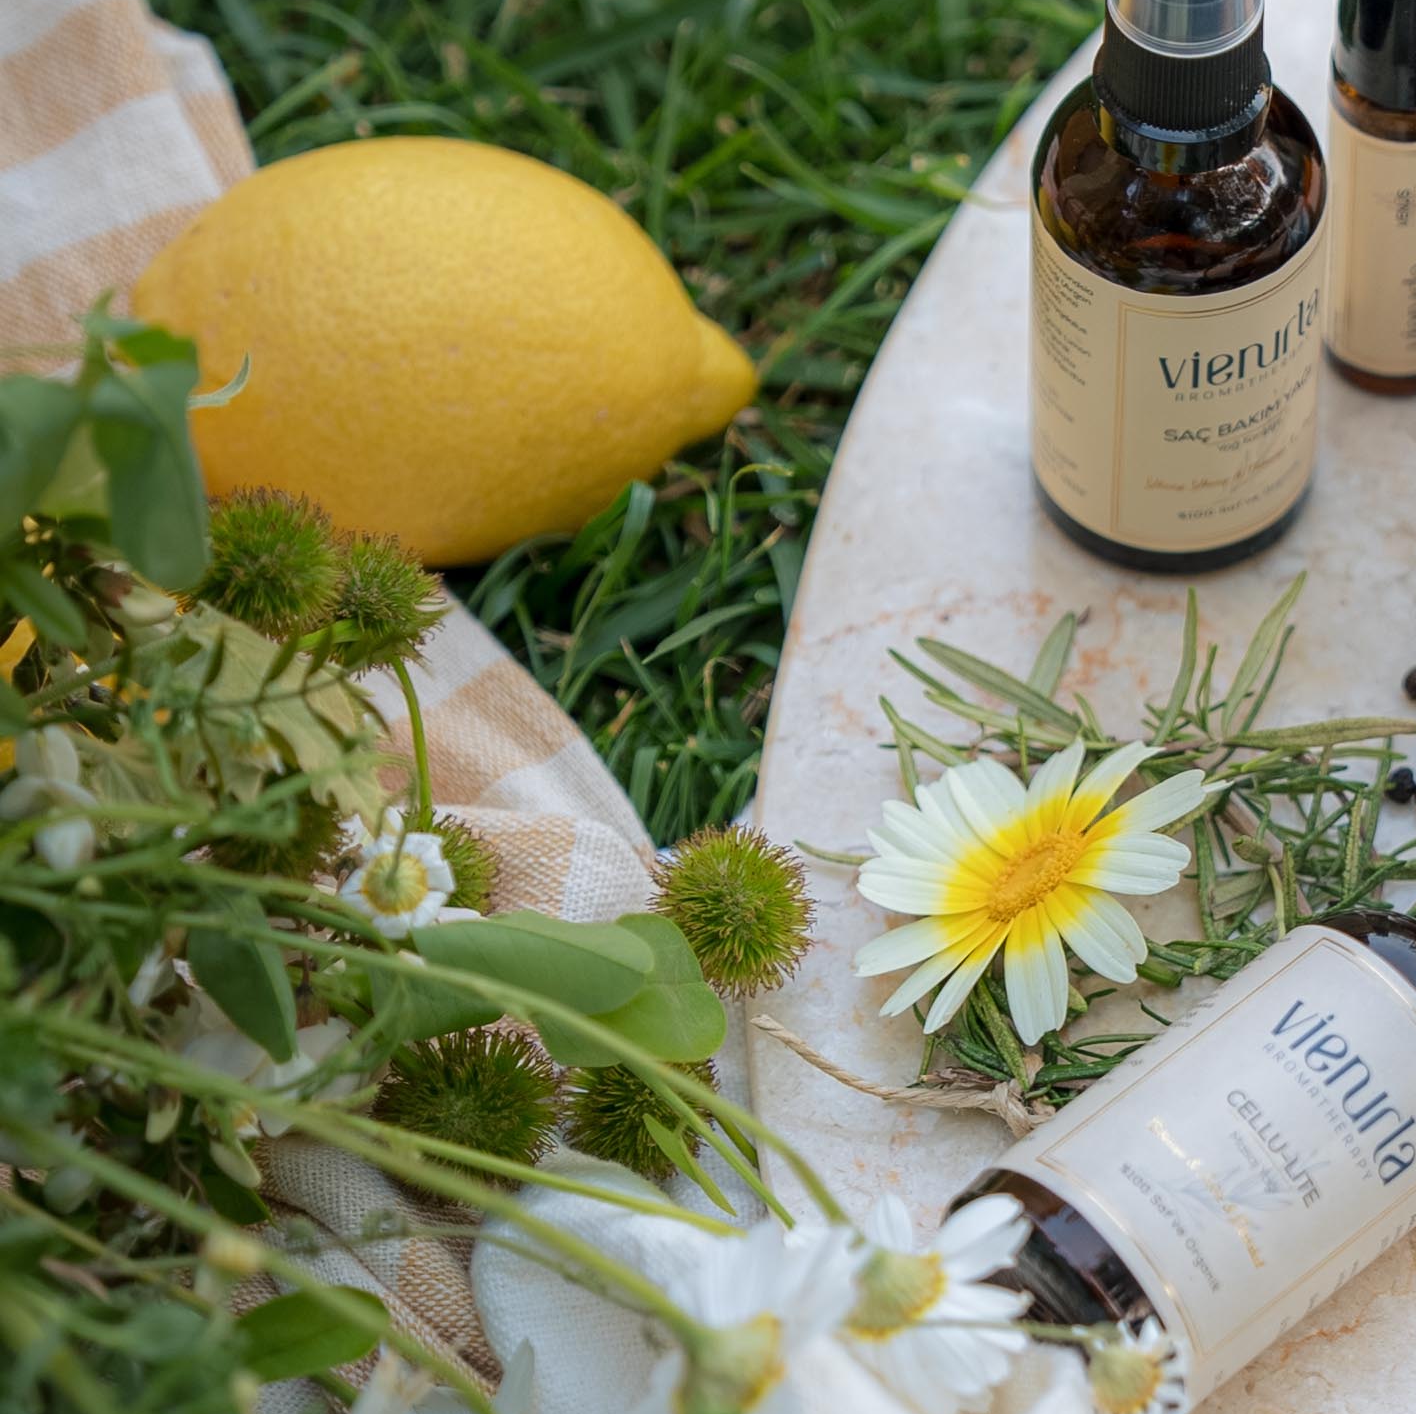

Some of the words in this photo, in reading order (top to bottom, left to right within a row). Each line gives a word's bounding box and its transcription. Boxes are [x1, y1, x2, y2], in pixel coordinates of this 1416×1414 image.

[1163, 428, 1212, 444] SAÇ
[1217, 399, 1281, 437] BAKIM
[1262, 1041, 1373, 1181] AROMATHERAPY
[1270, 999, 1416, 1187] vienurla
